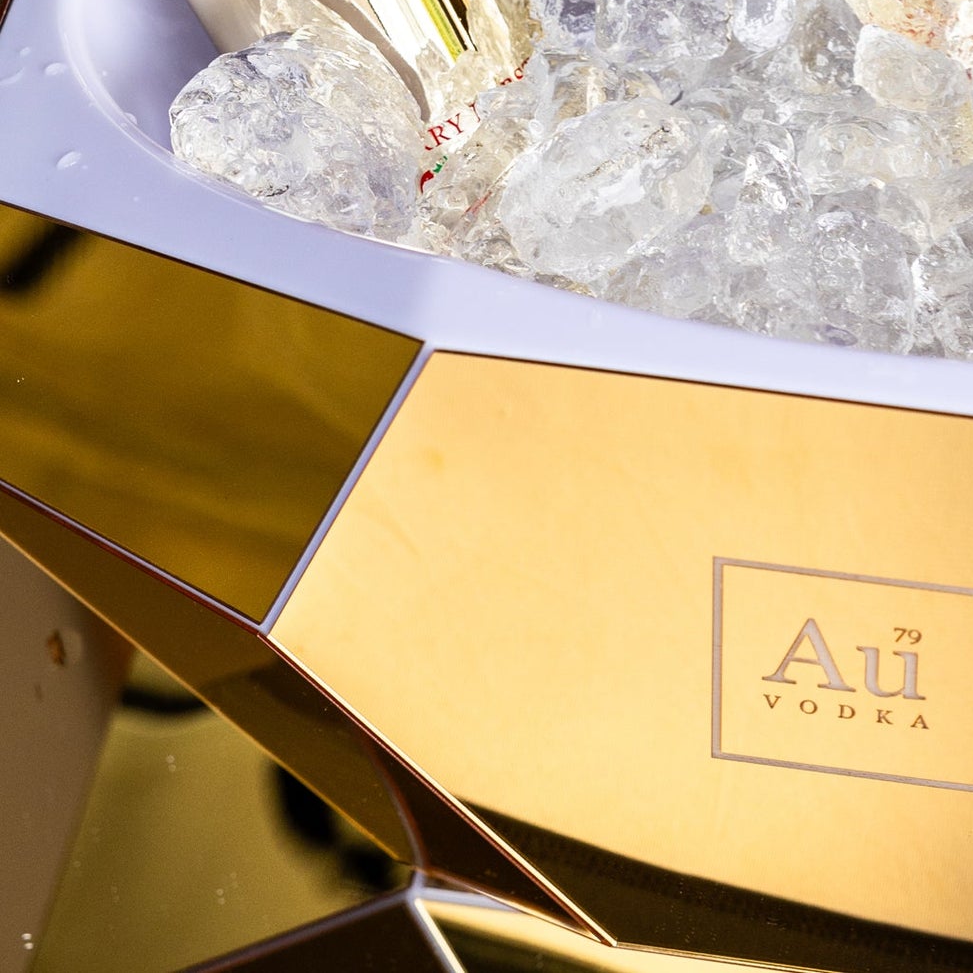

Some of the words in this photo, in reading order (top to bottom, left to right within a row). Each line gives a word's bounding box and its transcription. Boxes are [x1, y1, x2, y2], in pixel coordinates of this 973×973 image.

[893, 627, 922, 645] 79
[762, 617, 927, 701] Au
[763, 694, 930, 730] VODKA
